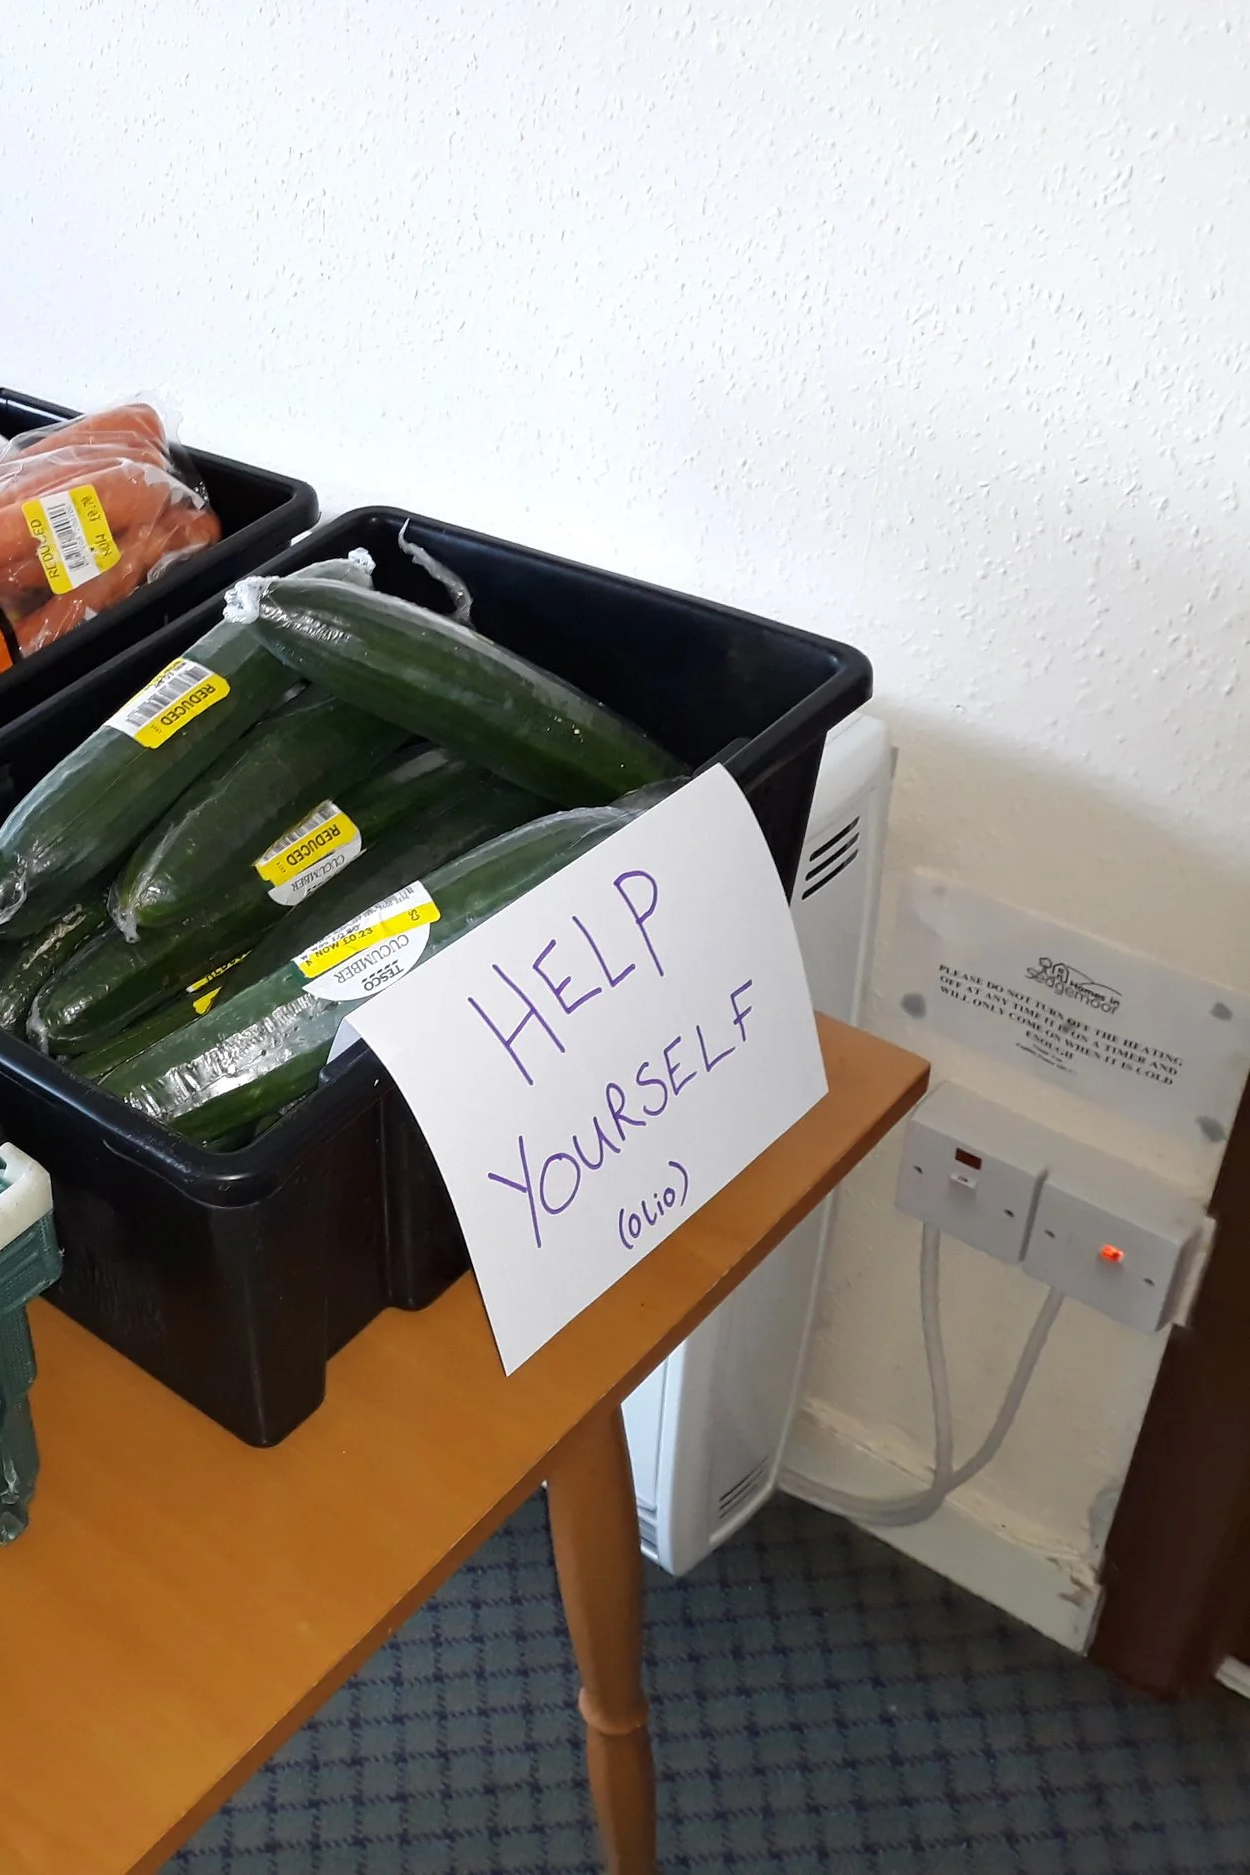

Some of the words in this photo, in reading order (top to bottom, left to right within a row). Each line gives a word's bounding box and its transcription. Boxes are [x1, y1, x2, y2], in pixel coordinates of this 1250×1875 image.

[160, 683, 217, 726] REDUCED
[286, 823, 341, 866] REDUCED
[291, 854, 346, 892] CUCUMBER
[333, 933, 410, 984] CUCUMBER
[343, 926, 374, 945] £0.23
[363, 963, 405, 992] TESCO
[468, 870, 664, 1086] HELP
[939, 964, 982, 984] PLEASE
[1007, 989, 1030, 1003] NOT
[1035, 1001, 1064, 1020] TURN
[1094, 1028, 1118, 1043] THE
[972, 998, 1005, 1016] ONLY
[1008, 1012, 1041, 1031] COME
[1065, 1037, 1102, 1060] WHEN
[1136, 1066, 1173, 1086] COLD
[1012, 1002, 1040, 1019] TIME
[1105, 1043, 1147, 1065] TIMER
[1150, 1060, 1178, 1076] AND
[1025, 1029, 1074, 1060] ENOUGH
[487, 979, 753, 1249] YOURSELF
